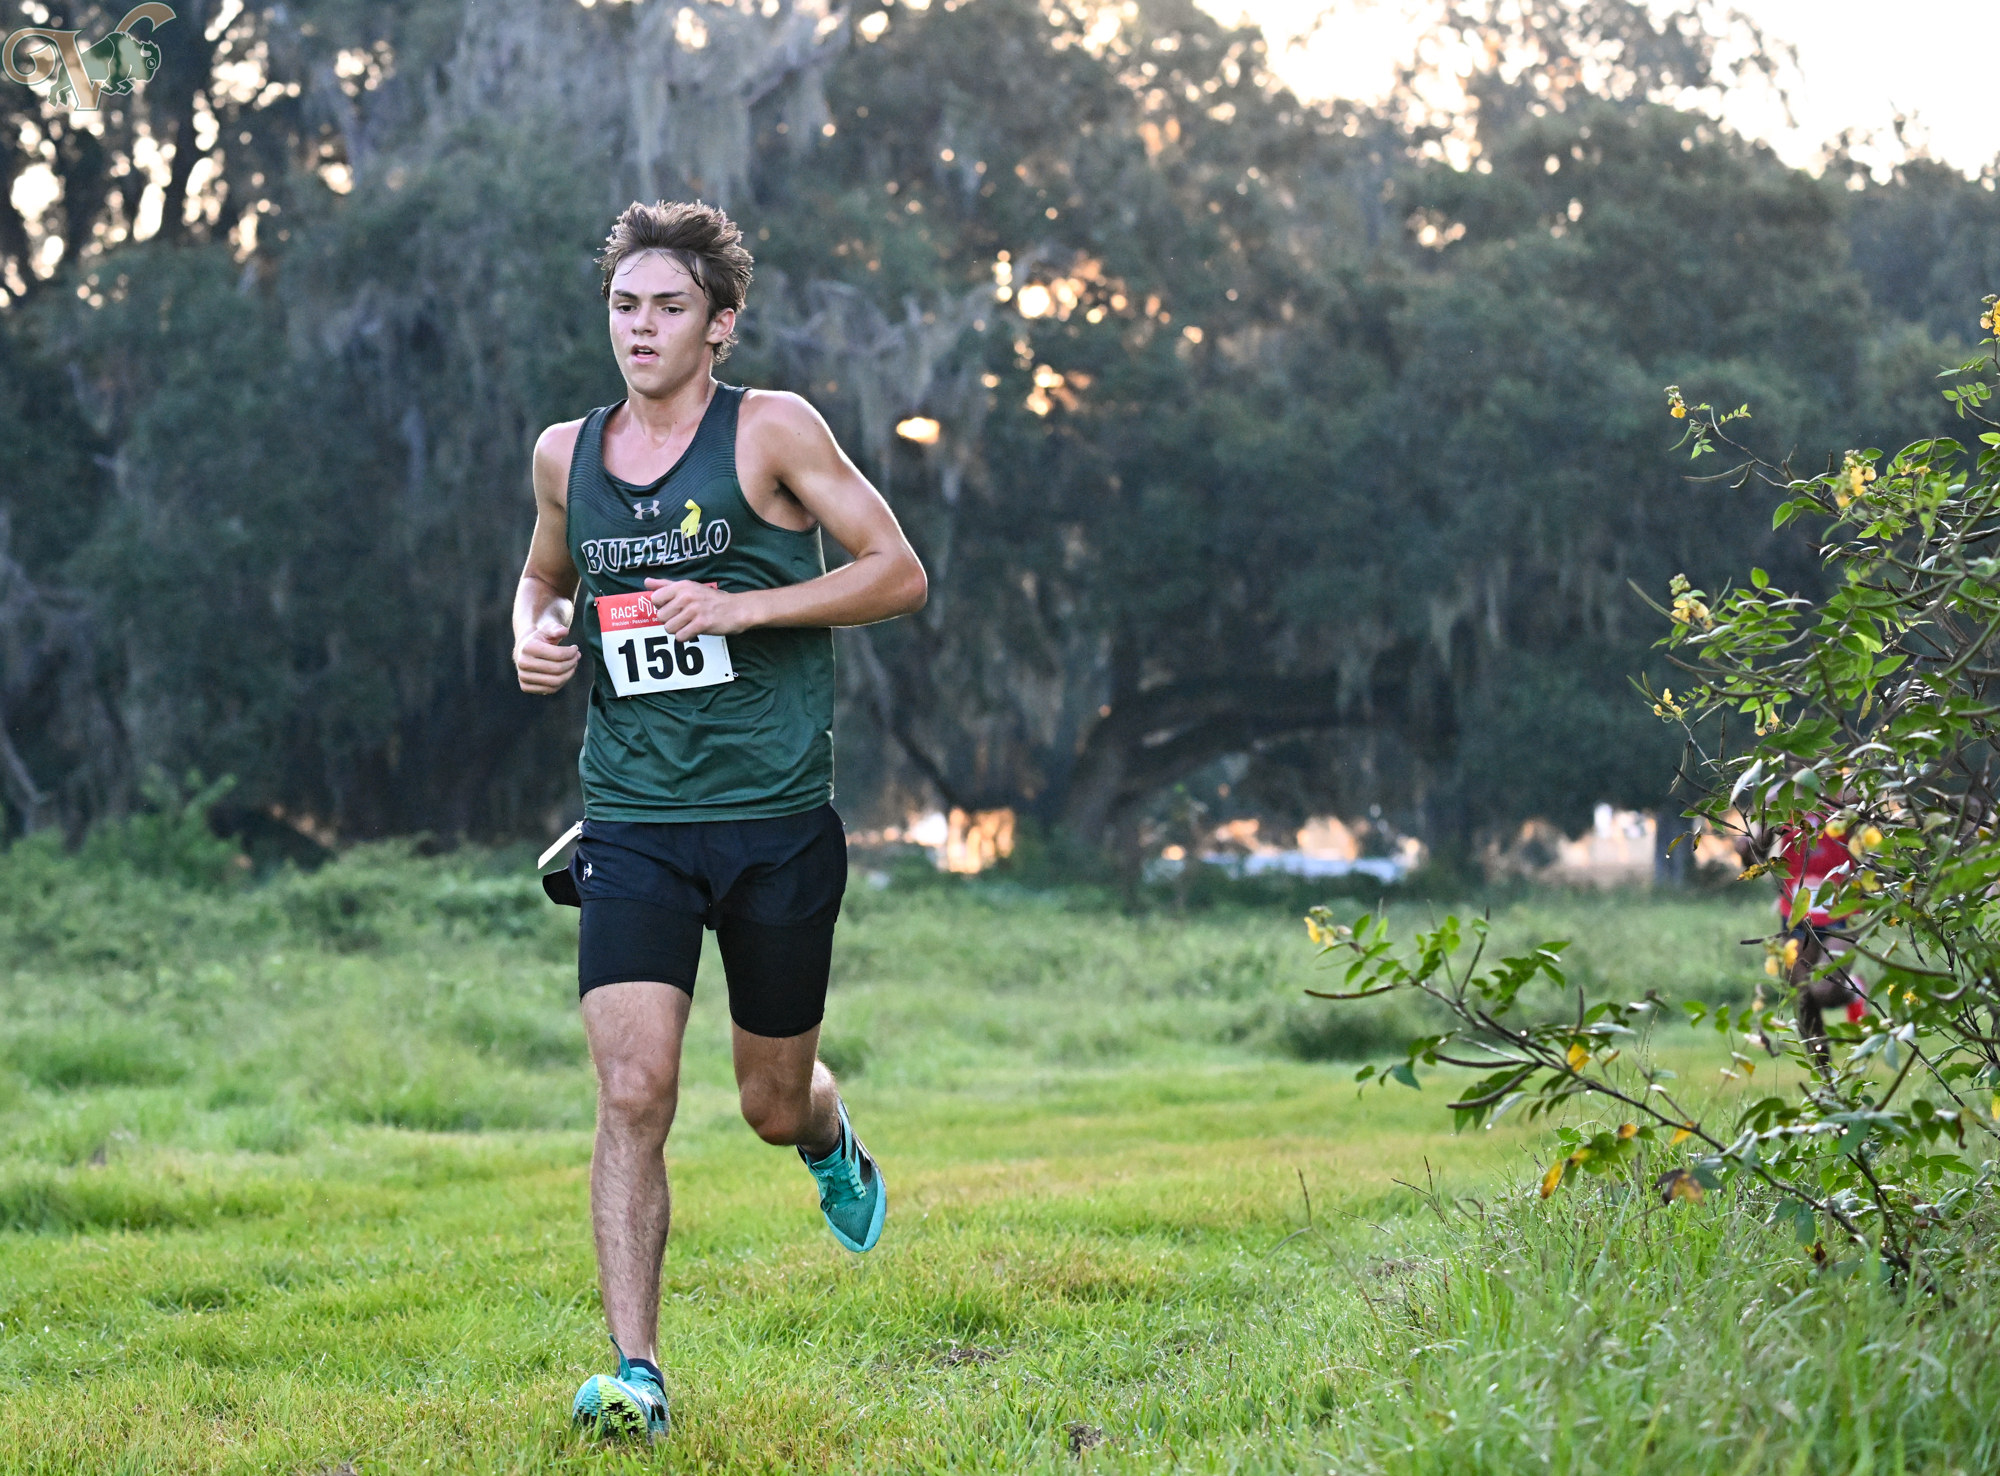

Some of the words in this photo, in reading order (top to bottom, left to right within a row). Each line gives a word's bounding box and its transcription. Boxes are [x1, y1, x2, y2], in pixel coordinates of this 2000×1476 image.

[581, 518, 731, 574] BUFFALO
[610, 605, 639, 620] RACE
[618, 635, 705, 683] 156
